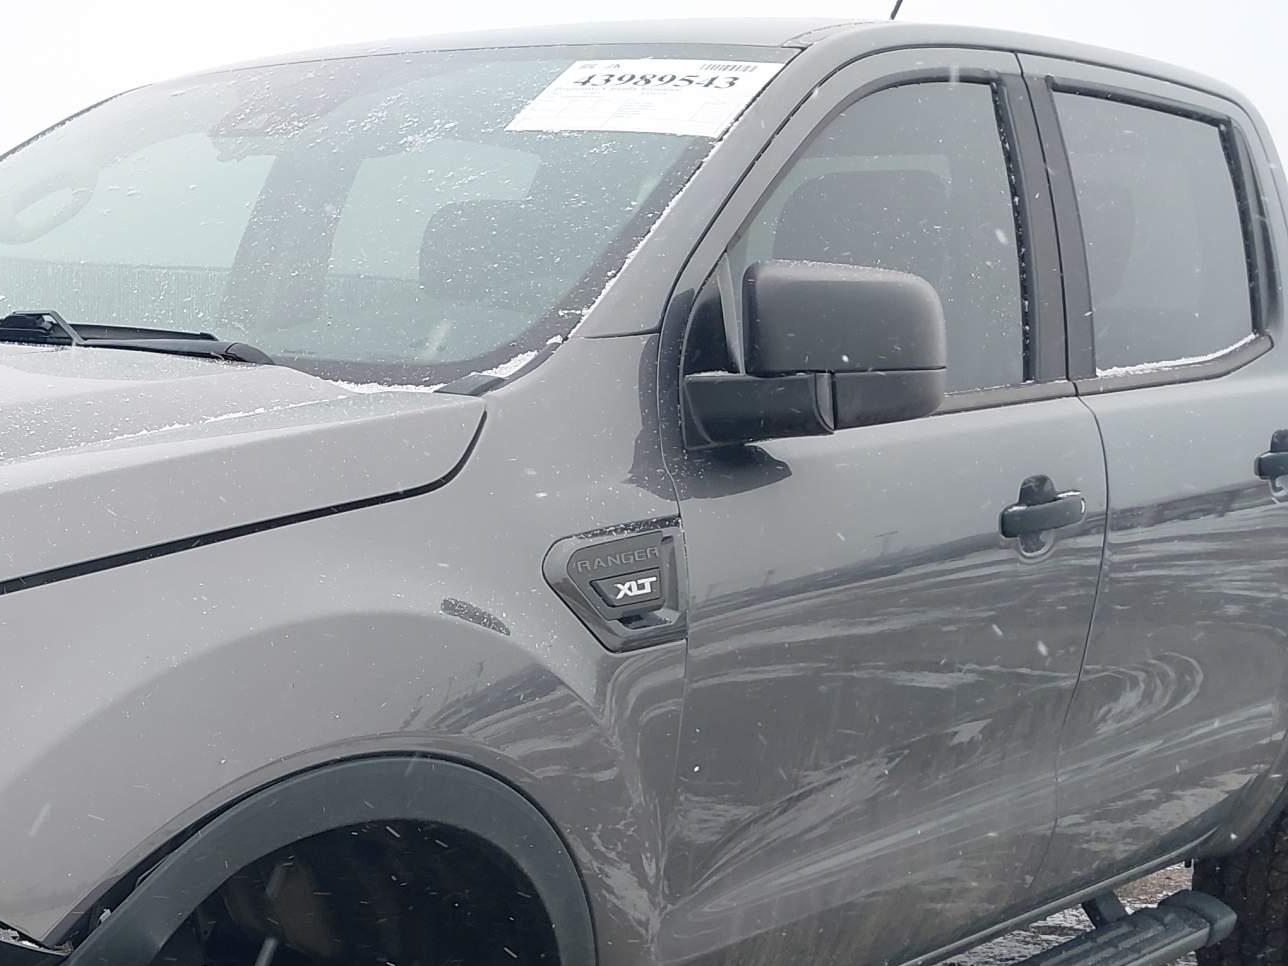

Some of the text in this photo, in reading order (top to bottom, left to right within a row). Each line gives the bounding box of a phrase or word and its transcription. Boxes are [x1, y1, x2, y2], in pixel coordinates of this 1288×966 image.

[574, 73, 740, 89] 43989543
[577, 547, 659, 573] RANGER
[614, 577, 656, 600] XLT
